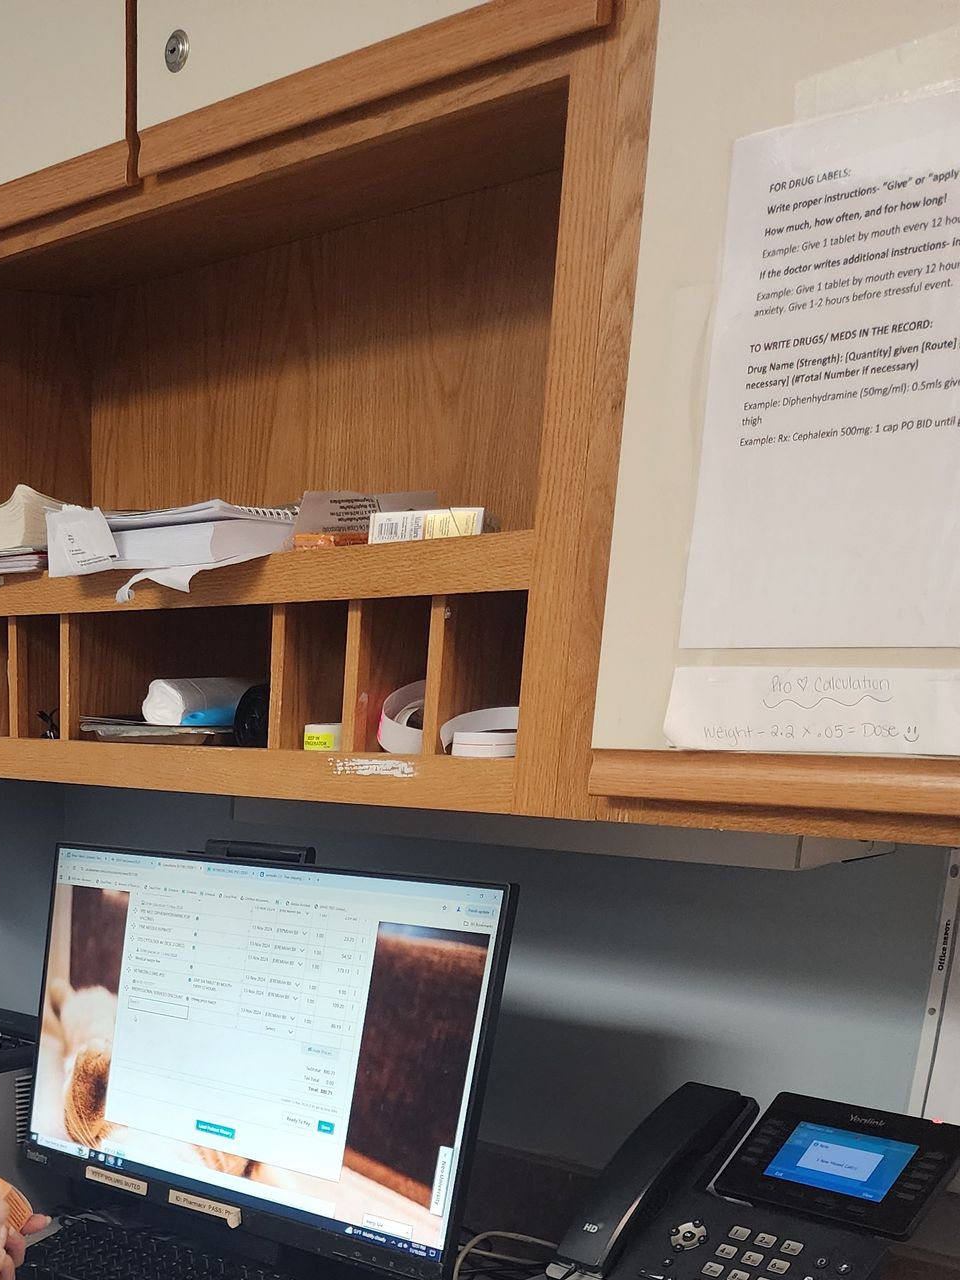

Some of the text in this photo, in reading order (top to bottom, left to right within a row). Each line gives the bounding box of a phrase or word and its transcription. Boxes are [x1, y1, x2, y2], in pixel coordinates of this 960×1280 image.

[766, 203, 791, 215] Write
[792, 196, 822, 212] proper
[823, 186, 880, 204] instructions-
[915, 176, 926, 185] or
[769, 167, 852, 193] FOR DRUG LABELS:
[764, 193, 948, 237] How much, how often, and for how long!
[762, 244, 800, 259] Example:
[801, 240, 821, 252] Give
[823, 238, 828, 248] 1
[830, 233, 856, 247] tablet
[858, 231, 869, 242] by
[871, 224, 901, 239] mouth
[902, 221, 929, 233] every
[931, 217, 943, 228] 12
[759, 270, 766, 280] If
[767, 268, 781, 279] the
[783, 264, 812, 276] doctor
[813, 259, 841, 270] writes
[843, 248, 889, 265] additional
[891, 241, 950, 257] instructions-
[754, 279, 953, 317] anxiety. Give 1-2 hours before stressful event.
[756, 287, 794, 301] Example:
[795, 284, 814, 295] Give
[824, 278, 850, 290] tablet
[852, 276, 863, 287] by
[865, 270, 895, 283] mouth
[897, 267, 923, 279] every
[925, 263, 937, 274] 12
[750, 319, 933, 353] TO WRITE DRUGS/ MEDS IN THE RECORD:
[747, 365, 767, 375] Drug
[769, 362, 794, 371] Name
[845, 346, 892, 363] [Quantity]
[893, 345, 919, 357] given
[921, 337, 957, 353] [Route]
[745, 376, 789, 390] necessary]
[824, 368, 860, 380] Number
[862, 365, 869, 375] if
[870, 359, 919, 373] necessary)
[744, 399, 780, 411] Example:
[782, 389, 858, 407] Diphenhydramine
[860, 382, 910, 399] (50mg/ml):
[912, 379, 942, 392] 0.5mls
[740, 415, 956, 446] Example: Rx: Cephalexin 500mg: 1 cap PO BID until
[742, 416, 762, 427] thigh
[814, 675, 890, 693] Calculation
[704, 725, 753, 745] Weight
[771, 724, 795, 738] 2.2
[862, 723, 899, 738] Dose
[937, 920, 951, 971] Office DEPOT
[848, 1113, 886, 1127] Yealink
[104, 1175, 124, 1185] VOLUME
[124, 1180, 141, 1191] MUTED
[434, 1174, 445, 1206] University
[583, 1223, 598, 1233] HD
